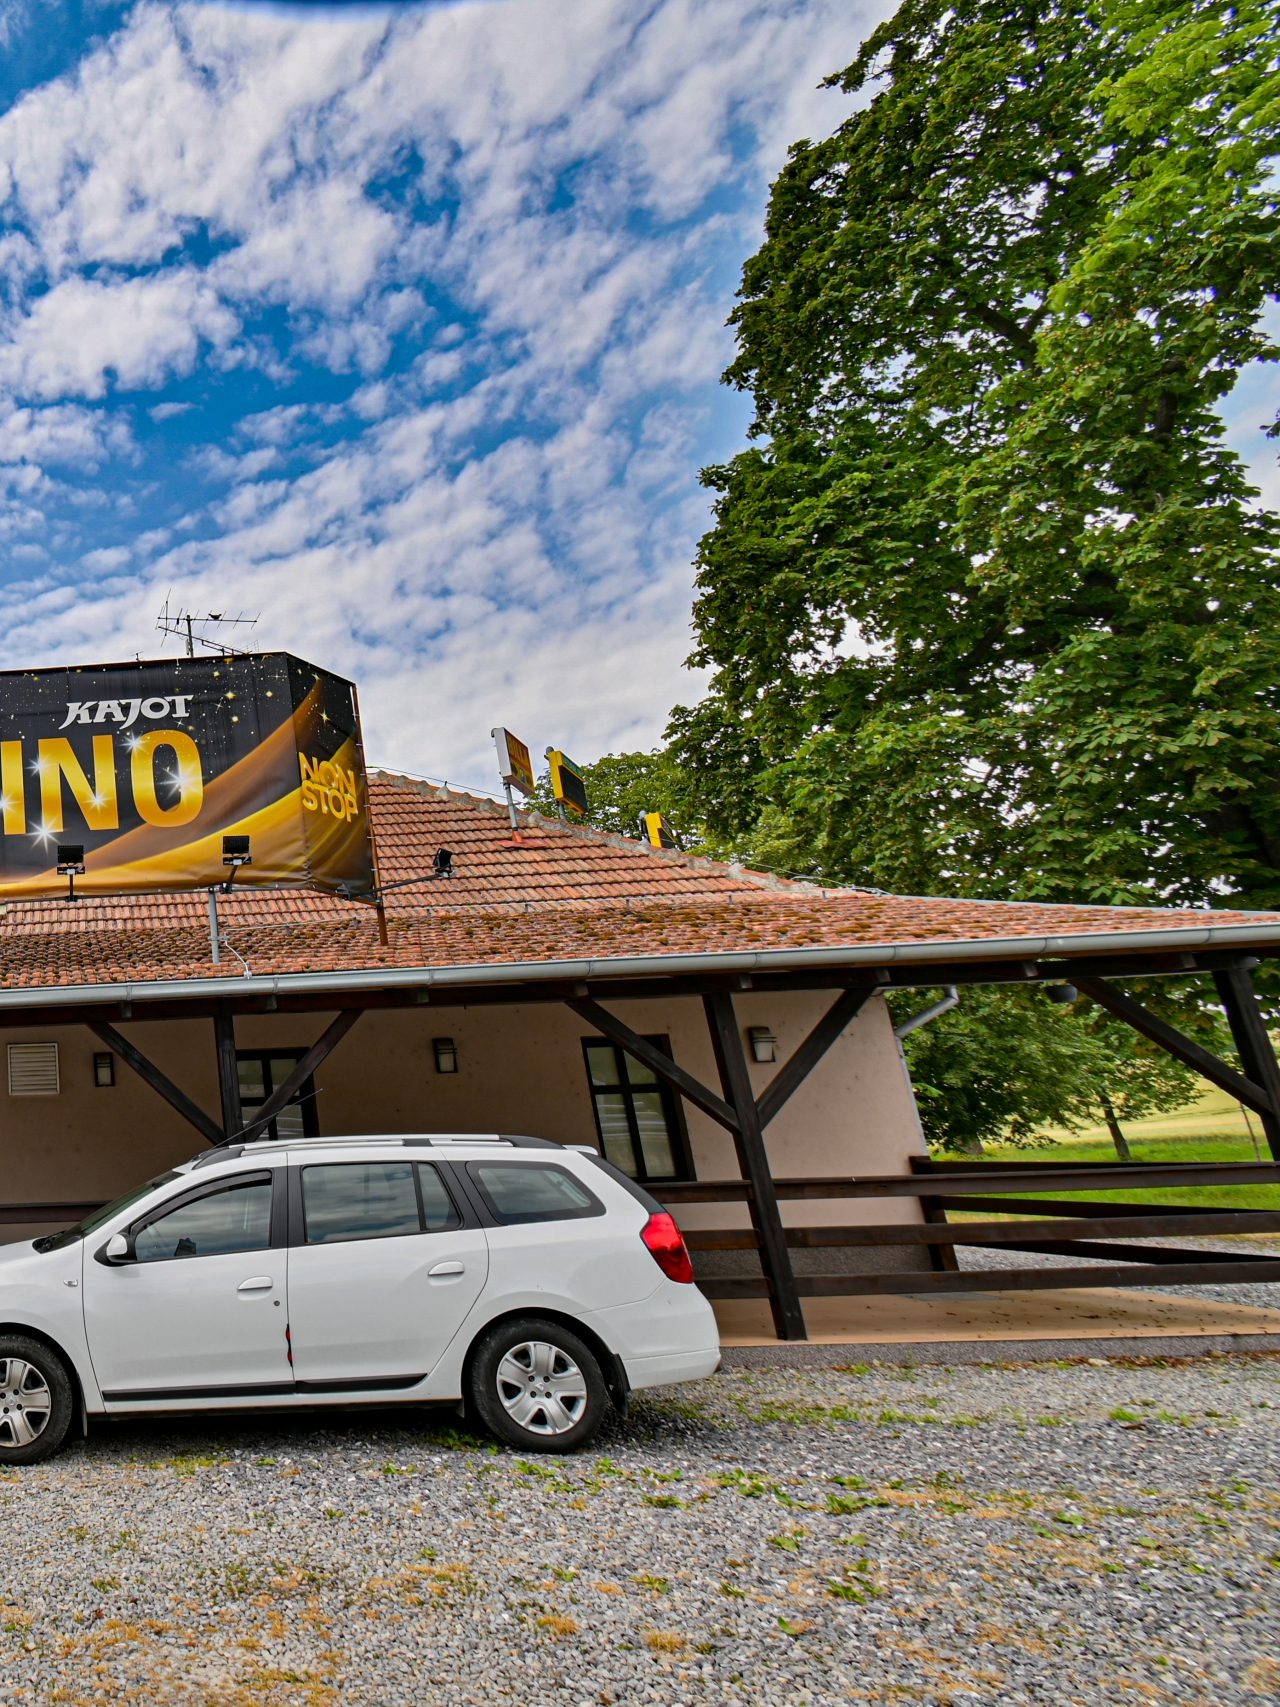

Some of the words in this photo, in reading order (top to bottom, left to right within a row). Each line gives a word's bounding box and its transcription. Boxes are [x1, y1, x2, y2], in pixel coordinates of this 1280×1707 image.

[58, 694, 194, 730] KAJOT
[299, 752, 357, 798] NON
[302, 780, 358, 822] STOP
